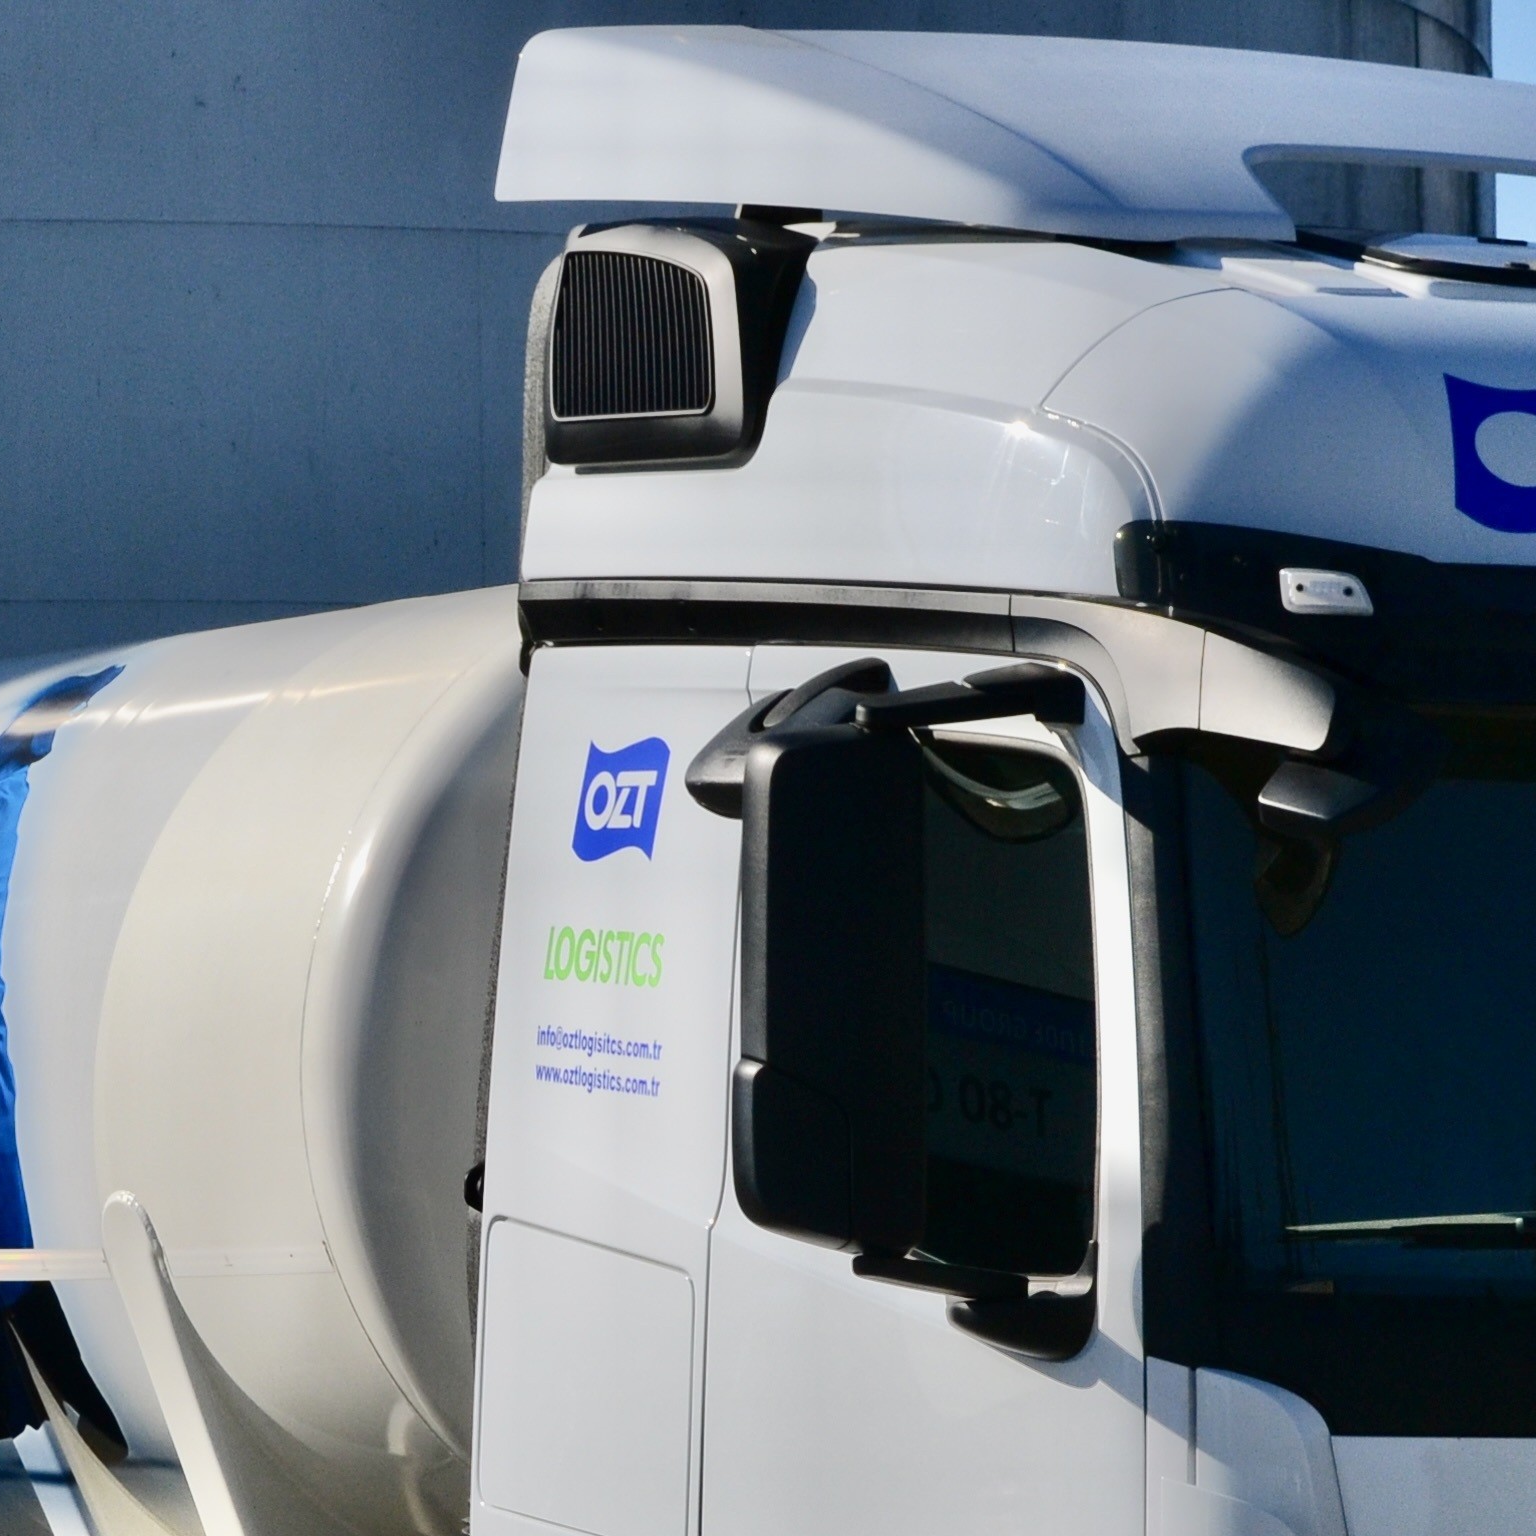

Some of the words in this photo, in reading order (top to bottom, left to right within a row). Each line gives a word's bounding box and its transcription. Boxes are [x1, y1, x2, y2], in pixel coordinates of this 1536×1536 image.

[584, 770, 658, 831] OZT
[544, 925, 664, 988] LOGISTICS
[537, 1025, 662, 1060] info@oztlogisitcs.com.tr
[535, 1064, 660, 1097] www.oztlogistics.com.tr
